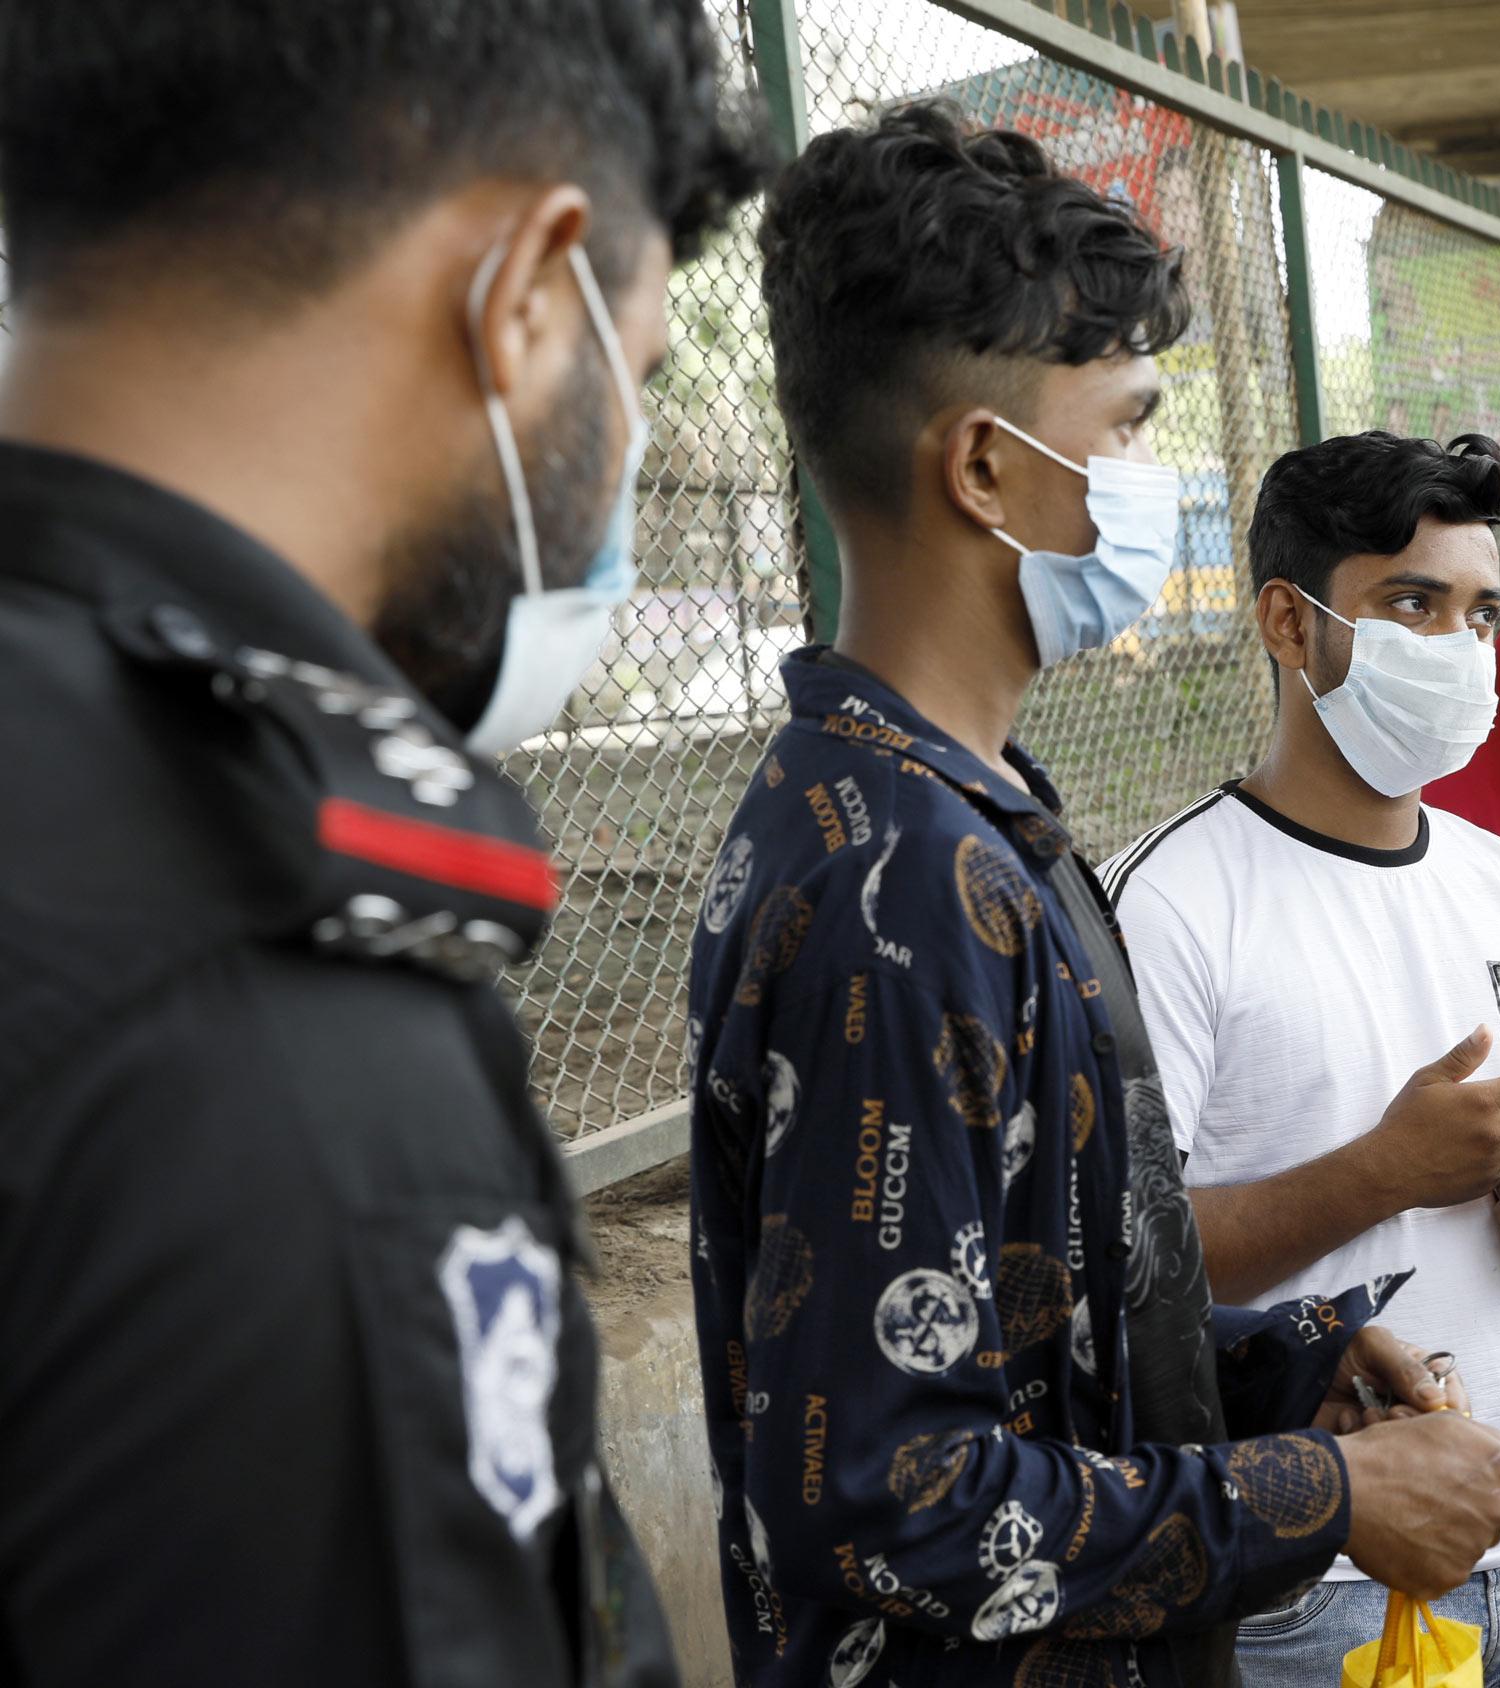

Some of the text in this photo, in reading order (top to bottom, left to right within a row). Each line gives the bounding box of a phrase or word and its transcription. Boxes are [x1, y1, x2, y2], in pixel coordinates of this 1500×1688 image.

[804, 782, 848, 854] BLOOM
[834, 776, 873, 847] GUCCM
[852, 1099, 885, 1222] BLOOM
[878, 1123, 913, 1251] GUCCM
[802, 1393, 828, 1506] ACTIVAED
[729, 1543, 773, 1635] GUCCM
